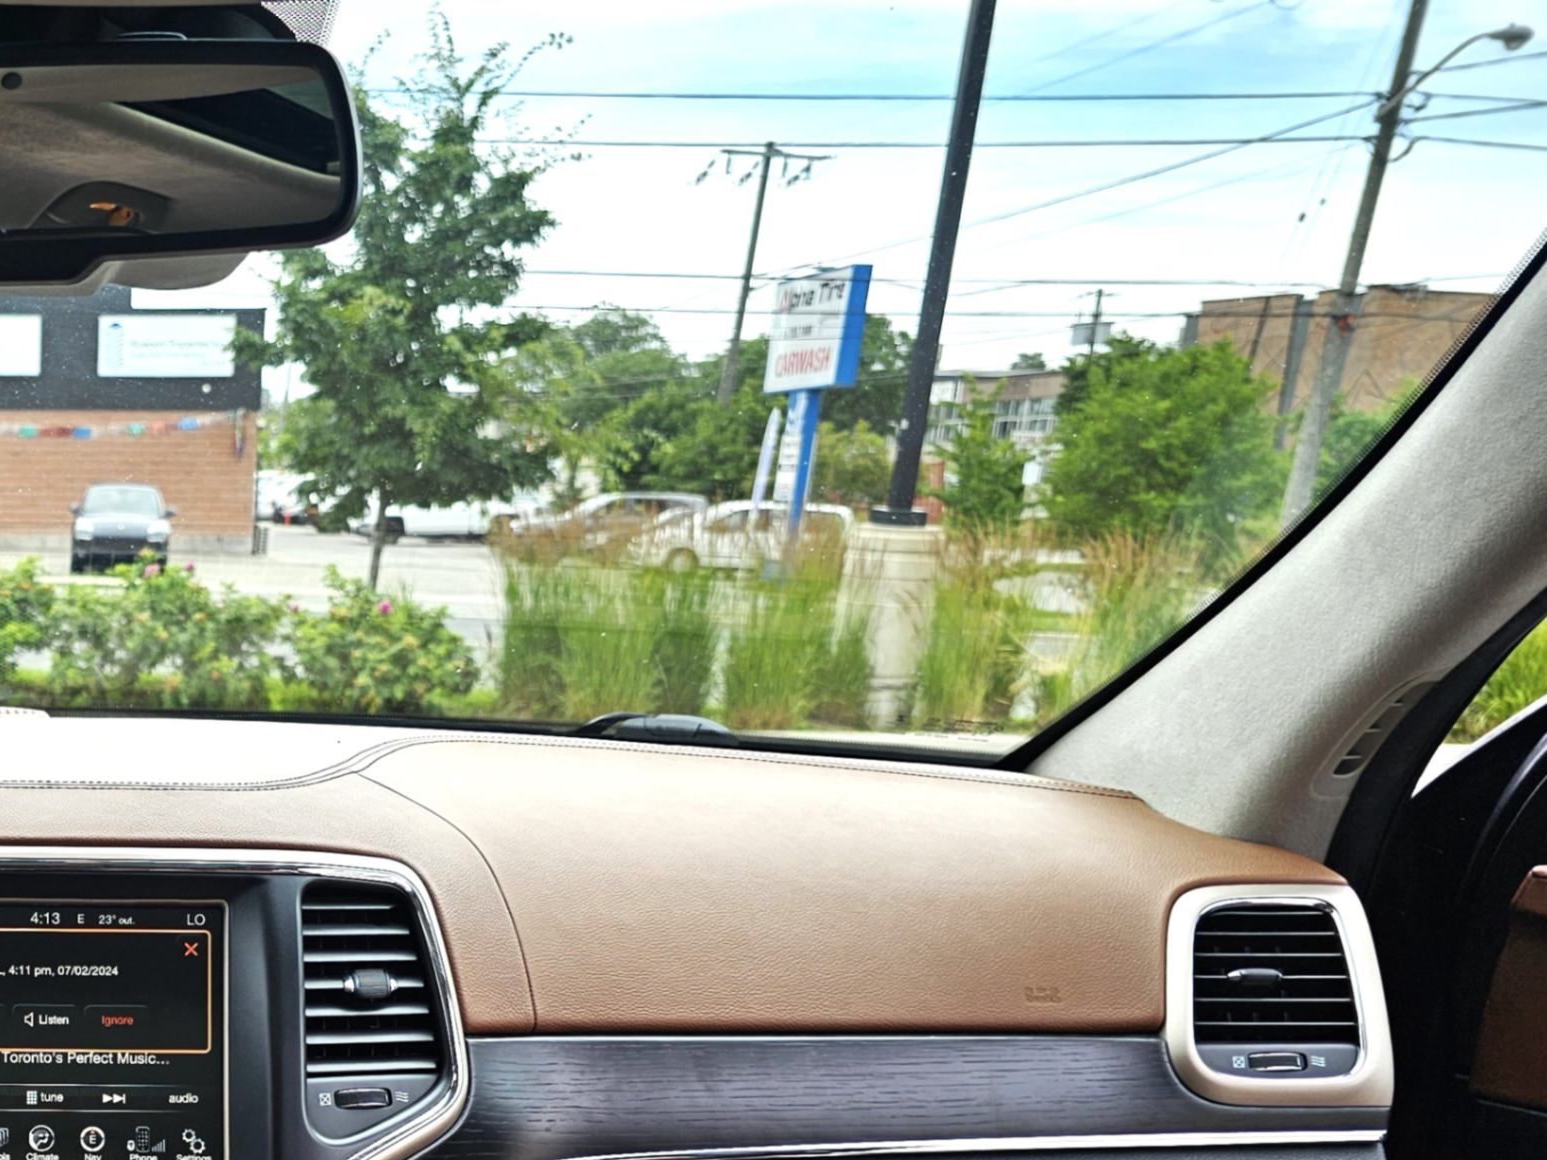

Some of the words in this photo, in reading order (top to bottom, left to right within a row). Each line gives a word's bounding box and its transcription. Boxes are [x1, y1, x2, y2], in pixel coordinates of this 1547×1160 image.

[775, 346, 831, 378] CARWASH
[30, 911, 61, 924] 4:13
[77, 913, 85, 924] E
[187, 913, 206, 926] LO
[8, 965, 31, 975] 4:11
[34, 967, 55, 978] pm,
[57, 965, 119, 976] 07/02/2024
[38, 1014, 70, 1025] Listen
[101, 1015, 134, 1027] Ignore
[2, 1052, 63, 1064] Toronto's
[67, 1052, 113, 1064] Perfect
[117, 1052, 170, 1065] Music...
[40, 1091, 64, 1102] tune
[168, 1093, 199, 1104] audio
